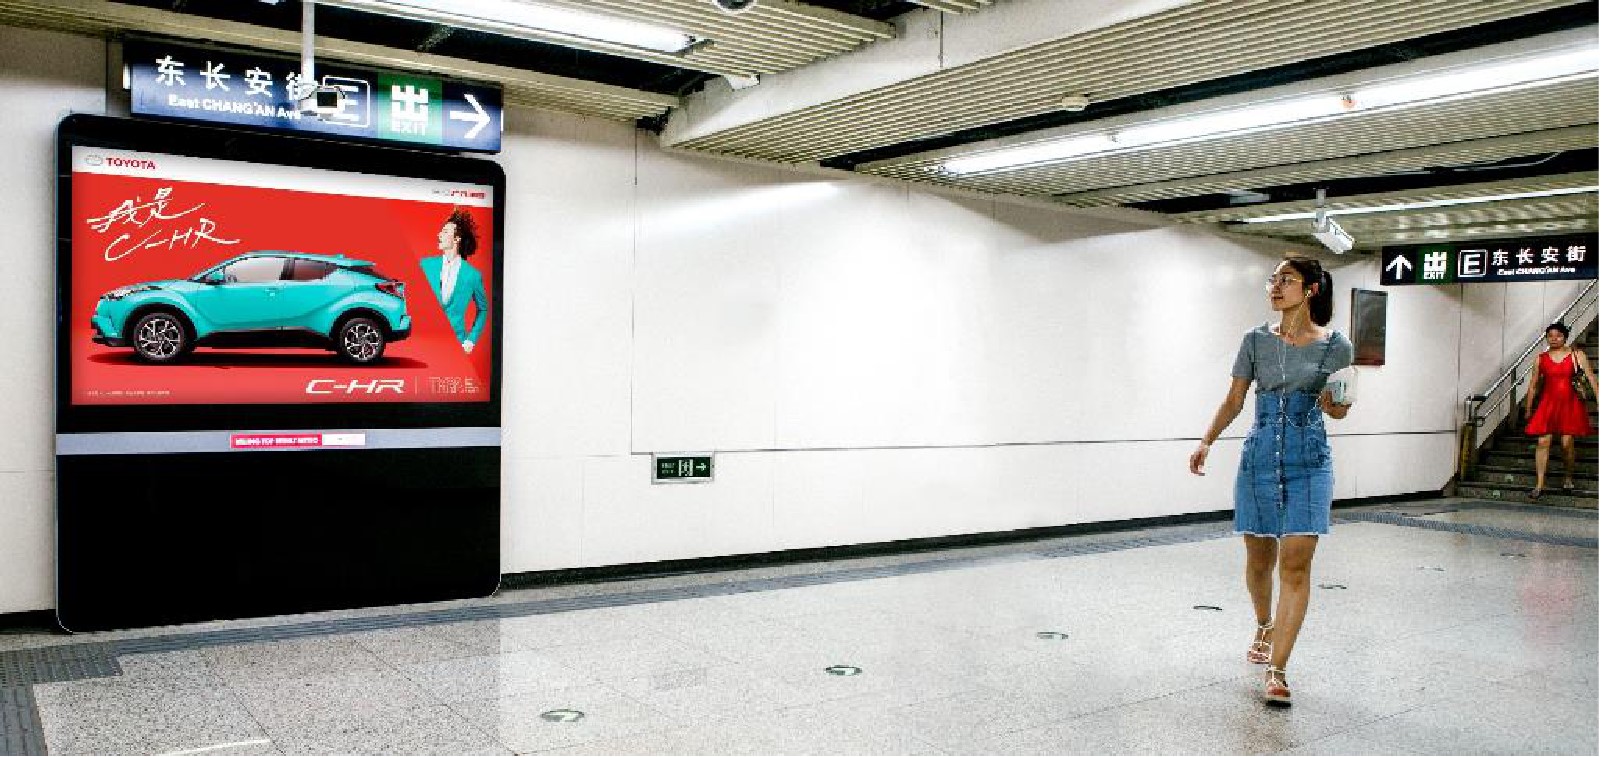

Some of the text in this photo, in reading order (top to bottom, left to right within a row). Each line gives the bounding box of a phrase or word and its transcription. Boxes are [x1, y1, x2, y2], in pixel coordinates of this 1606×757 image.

[391, 85, 429, 121] 出
[391, 118, 429, 136] EXIT
[106, 157, 156, 170] TOYOTA
[104, 217, 241, 262] C-HR
[1423, 251, 1447, 272] 出
[1463, 253, 1481, 275] E
[1491, 245, 1587, 266] 东长安街
[1423, 271, 1446, 280] EXIT
[305, 378, 405, 394] C-HR
